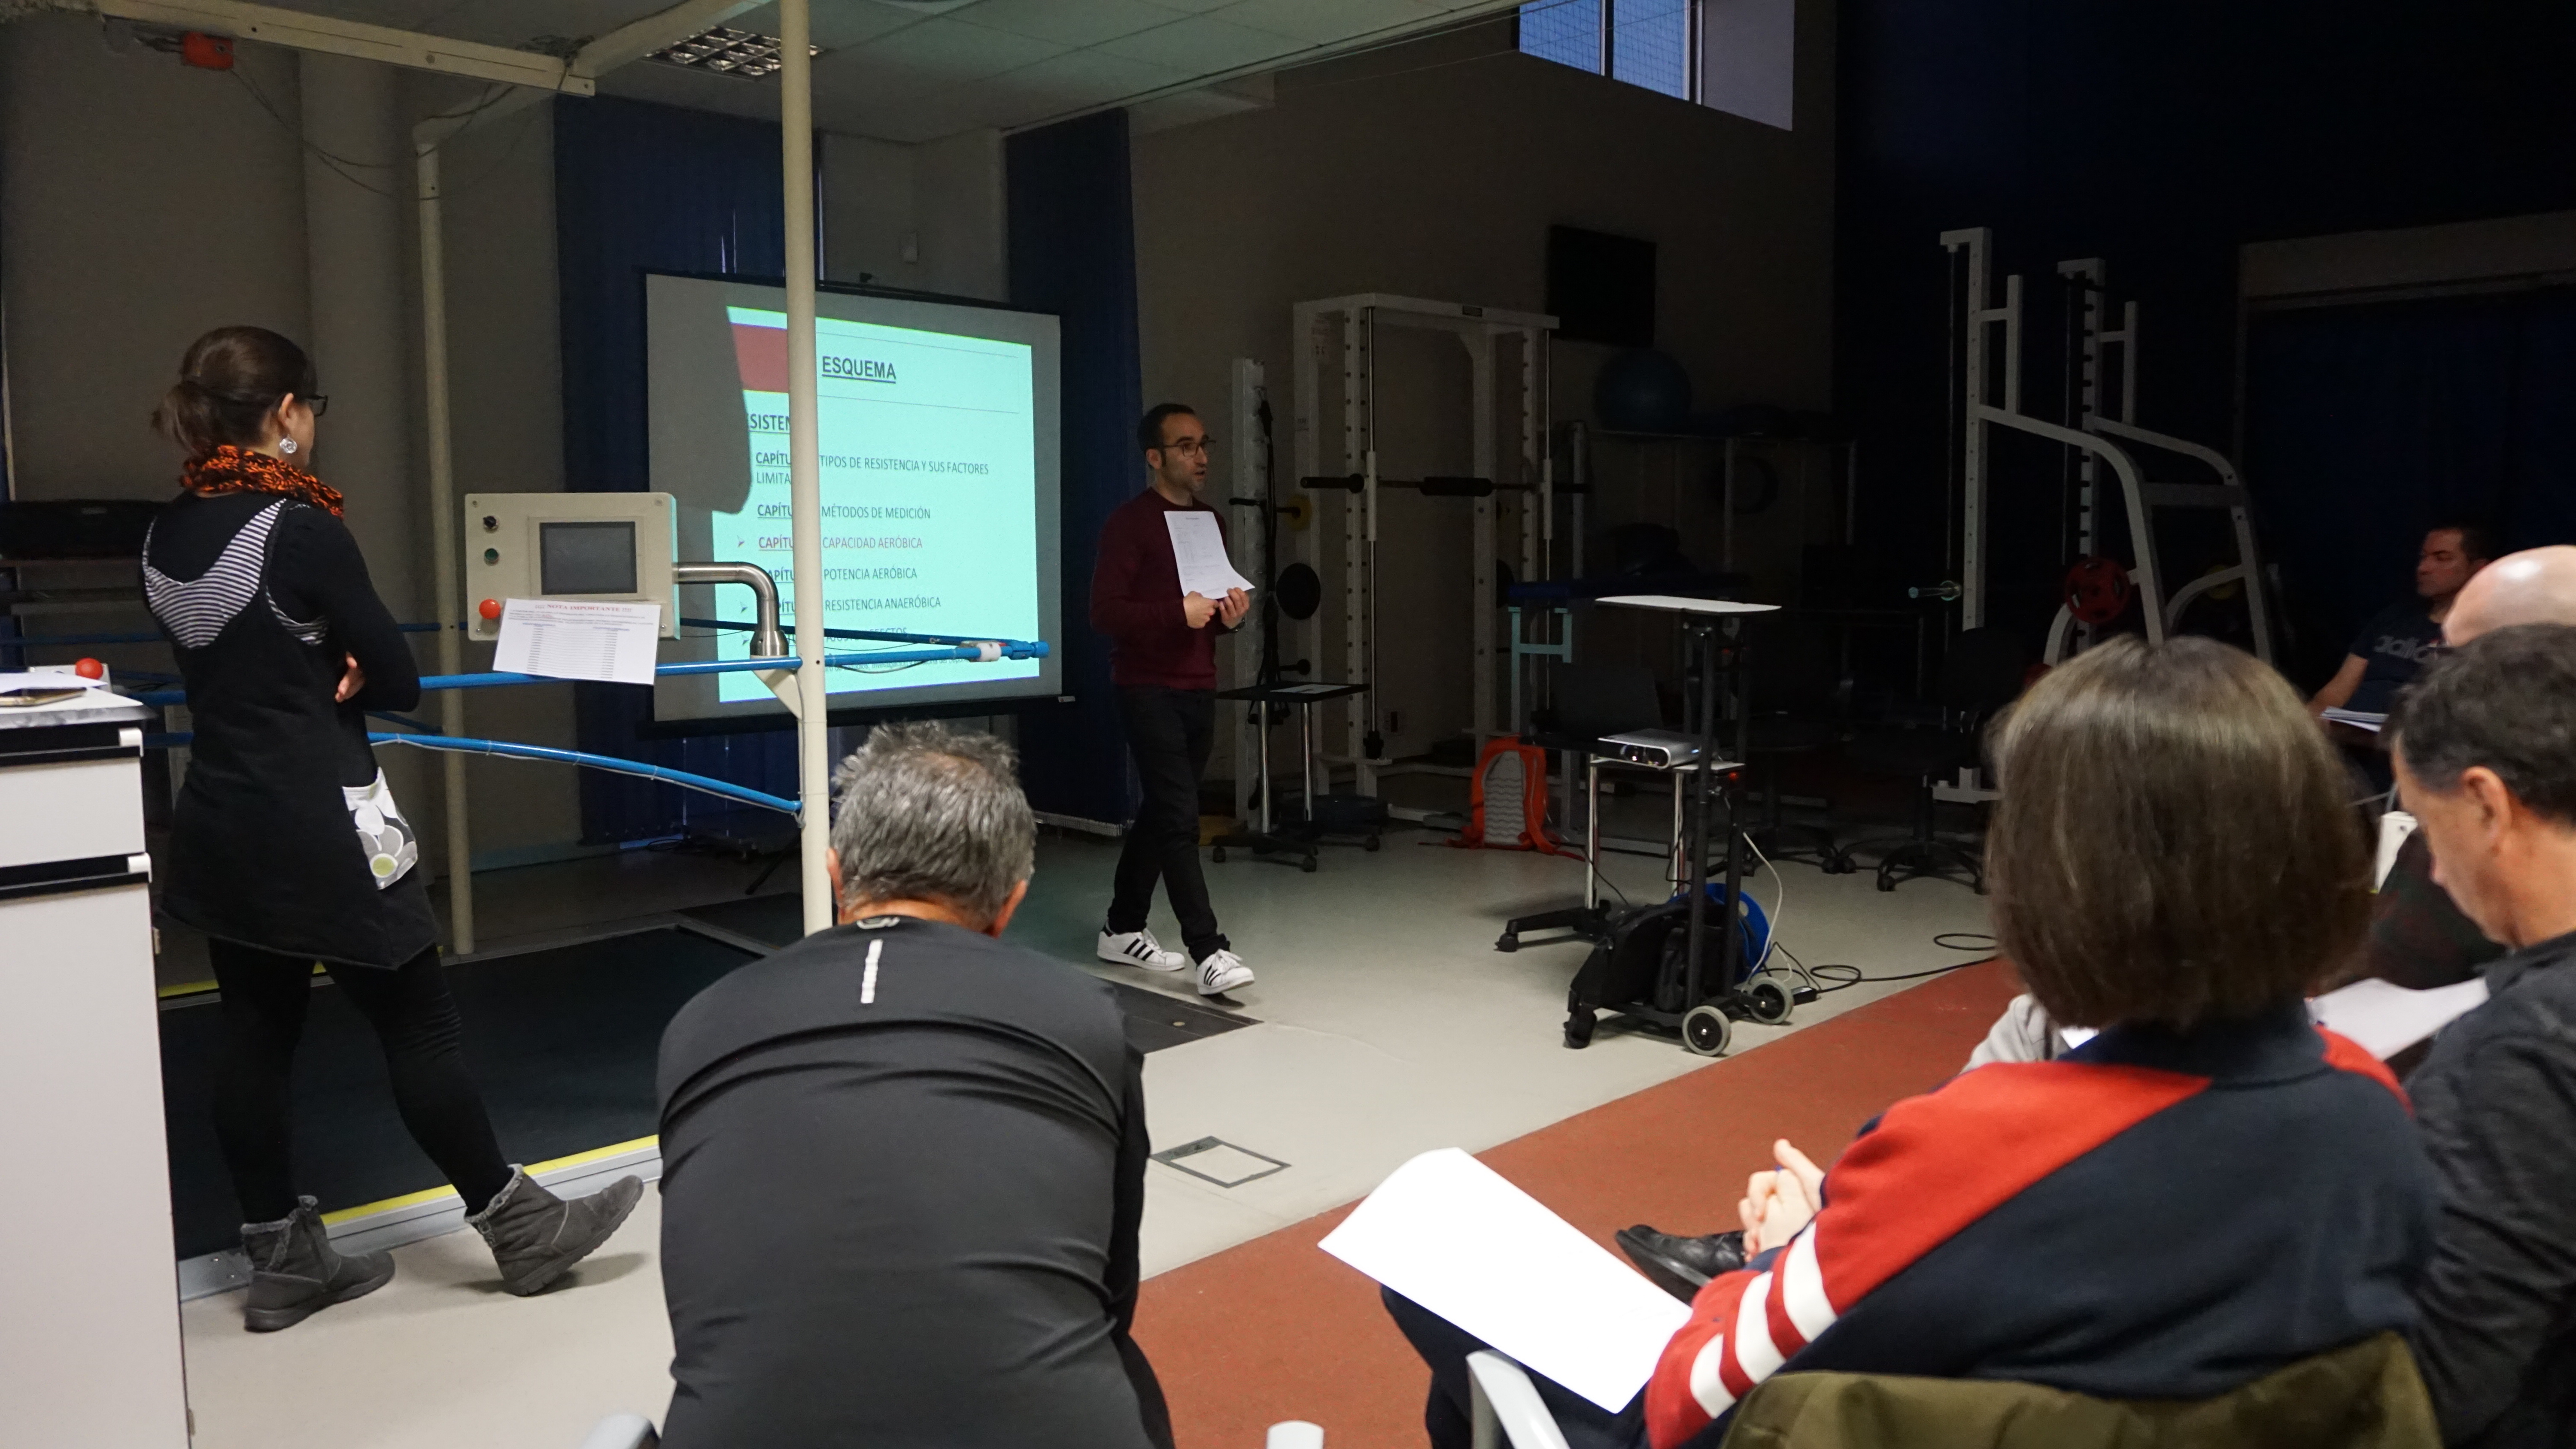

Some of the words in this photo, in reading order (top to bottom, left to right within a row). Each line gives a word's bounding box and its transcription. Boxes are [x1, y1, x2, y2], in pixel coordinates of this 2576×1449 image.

[822, 355, 896, 379] ESQUEMA
[756, 450, 791, 464] CAPÍTU
[819, 455, 847, 468] TIPOS
[850, 457, 861, 469] DE
[865, 458, 919, 471] RESISTENCIA
[921, 461, 927, 471] Y
[929, 461, 945, 473] SUS
[947, 462, 988, 474] FACTORES
[756, 472, 791, 485] LIMITA
[757, 502, 792, 517] CAPÍTU
[822, 503, 869, 518] MÉTODOS
[872, 507, 883, 518] DE
[885, 506, 930, 519] MEDICIÓN
[759, 534, 793, 549] CAPÍTU
[823, 537, 875, 549] CAPACIDAD
[878, 535, 923, 549] AERÓBICA
[824, 568, 870, 580] POTENCIA
[872, 564, 917, 579] AERÓBICA
[825, 598, 883, 612] RESISTENCIA
[884, 594, 941, 609] ANAERÓBICA
